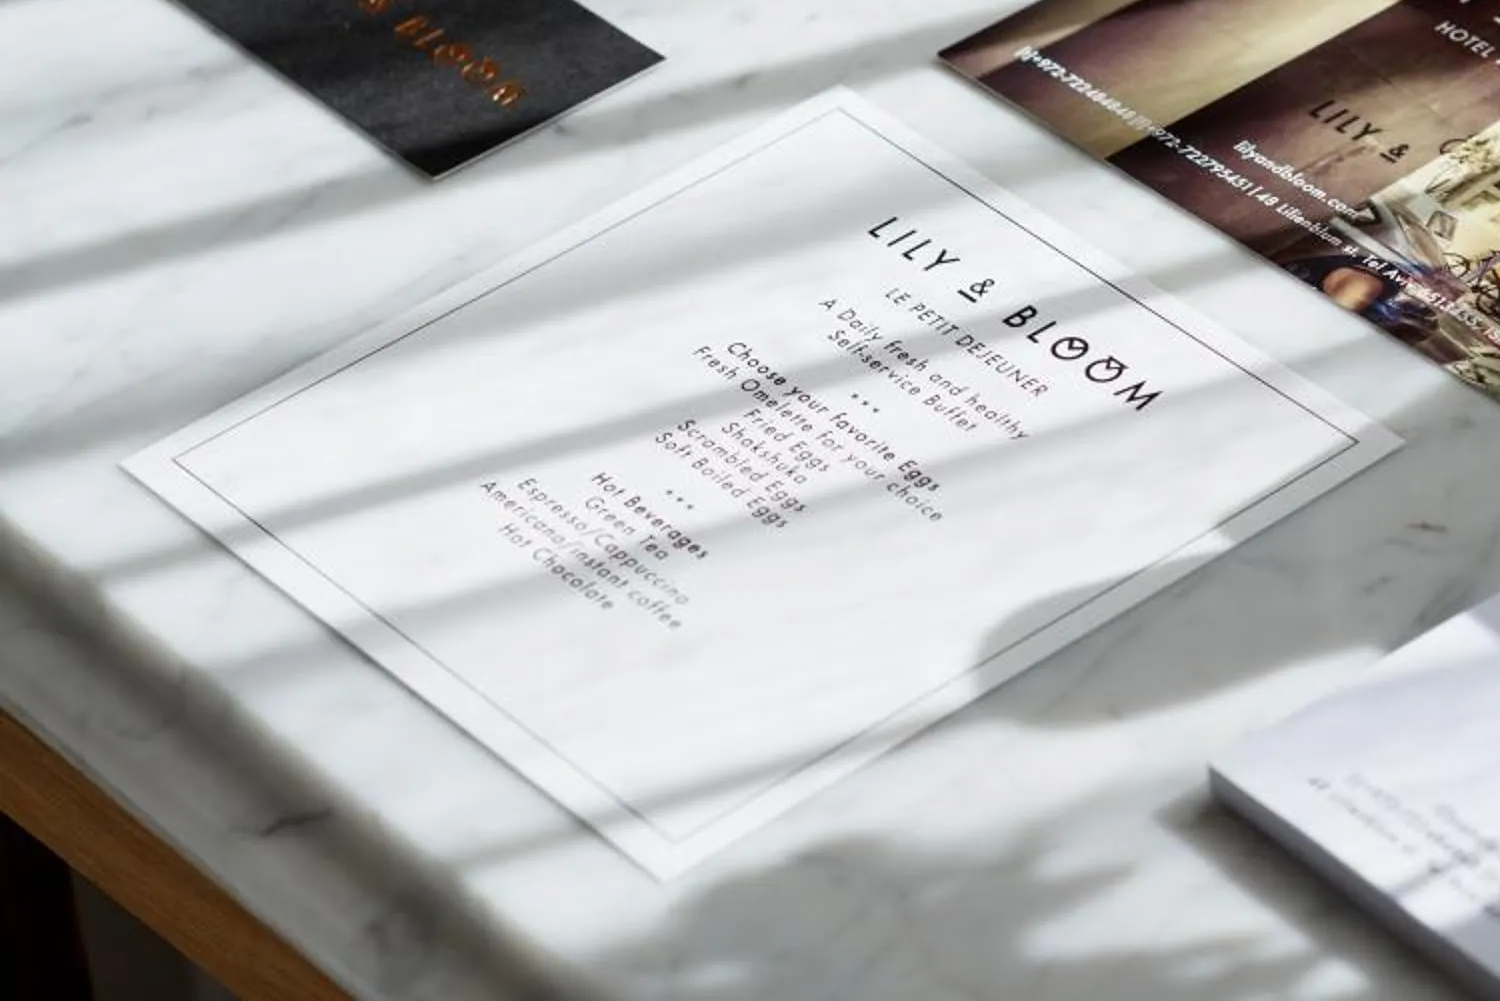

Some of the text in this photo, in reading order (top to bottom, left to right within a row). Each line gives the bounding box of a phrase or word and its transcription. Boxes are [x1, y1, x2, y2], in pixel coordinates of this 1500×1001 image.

[394, 15, 522, 107] BLOOM
[1434, 20, 1495, 58] HOTEL
[1308, 100, 1384, 142] LILY
[1233, 139, 1362, 217] lilyandbloom.com
[1255, 192, 1280, 207] 48
[1362, 254, 1388, 271] Tel
[867, 216, 1163, 412] LILY & BLOOM
[884, 287, 1049, 397] LE PETIT DEJEUNER
[818, 298, 1029, 440] A Daily fresh and healthy
[827, 329, 977, 432] Self-service Buffet
[692, 345, 943, 522] Fresh Omelette for your choice
[721, 422, 808, 485] Shakshuka
[727, 342, 941, 492] Choose your favorite Eggs
[743, 408, 830, 472] Fried Eggs
[655, 432, 789, 529] Soft Boiled Eggs
[676, 419, 808, 513] Scrambled Eggs
[584, 496, 669, 561] Green Tea
[591, 471, 708, 560] Hot Beverages
[498, 522, 614, 610] Hot Chocolate
[627, 590, 683, 629] coffee
